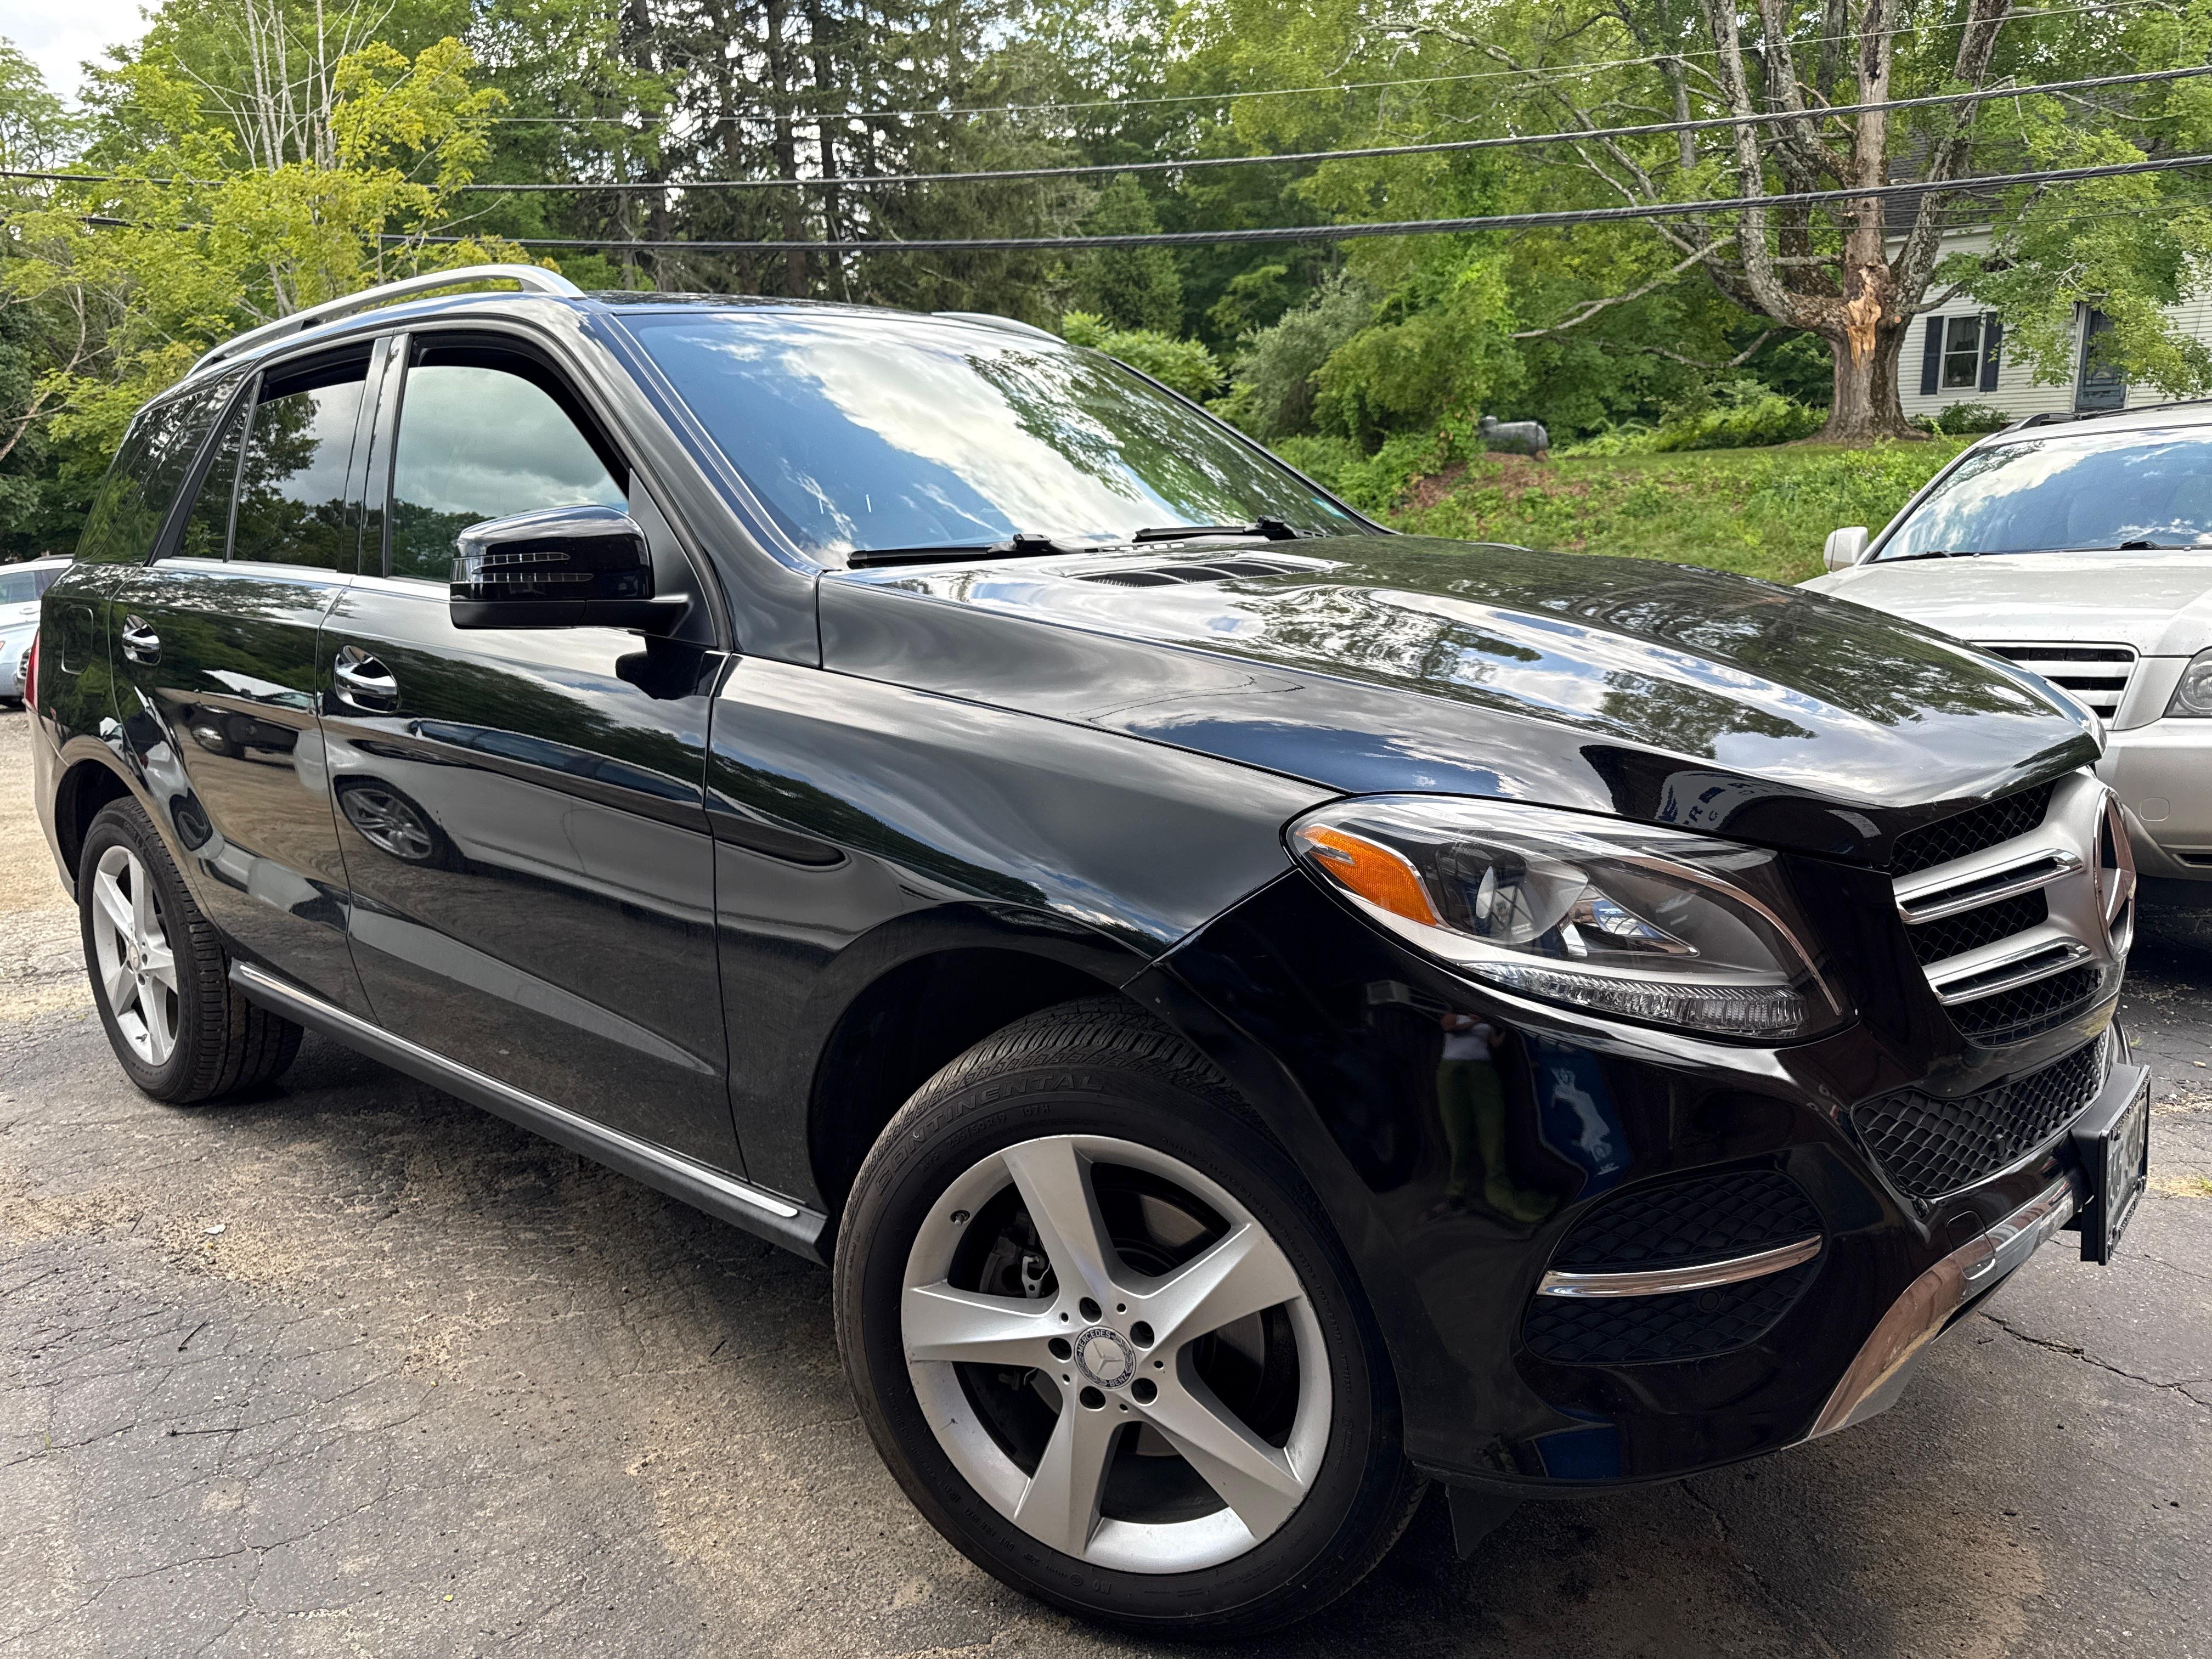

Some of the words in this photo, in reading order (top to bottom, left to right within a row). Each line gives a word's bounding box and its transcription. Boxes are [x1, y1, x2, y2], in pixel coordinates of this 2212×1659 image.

[876, 1074, 1103, 1195] CONTINENTAL
[1077, 1329, 1111, 1353] MERCEDES
[1109, 1373, 1129, 1387] BENZ
